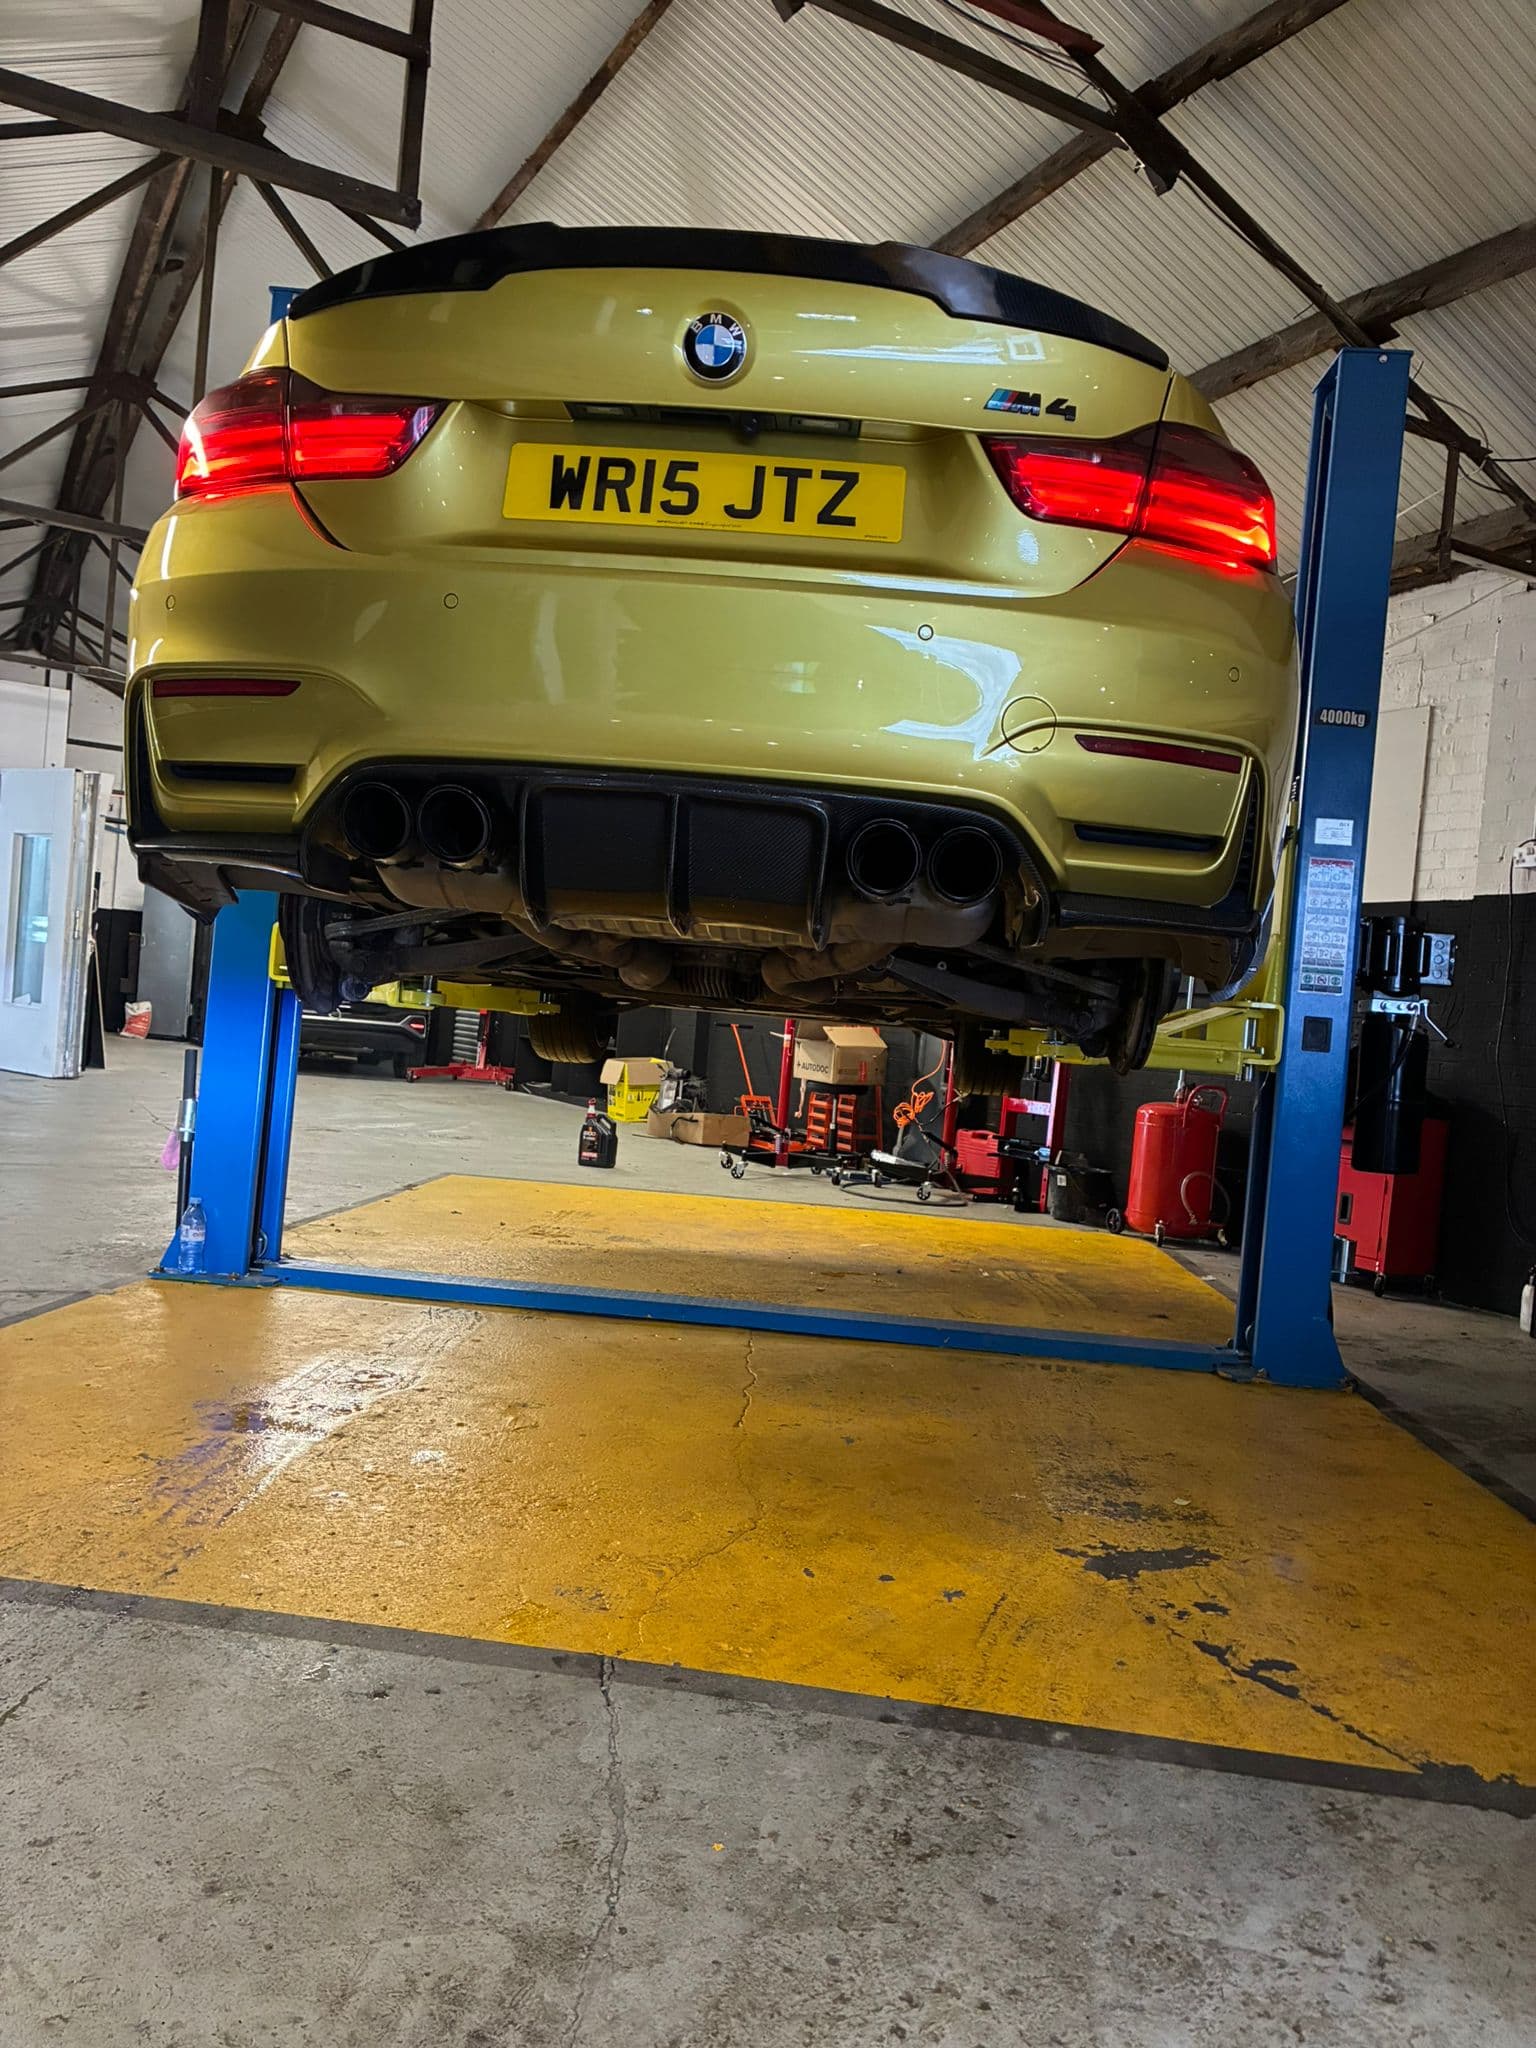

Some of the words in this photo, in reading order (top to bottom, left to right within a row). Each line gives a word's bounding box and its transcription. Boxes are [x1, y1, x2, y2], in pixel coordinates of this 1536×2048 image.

[691, 313, 742, 336] BMW
[550, 455, 699, 515] WR15
[724, 466, 860, 527] JTZ
[1320, 709, 1365, 727] 4000kg
[801, 1062, 829, 1074] AUTODOC
